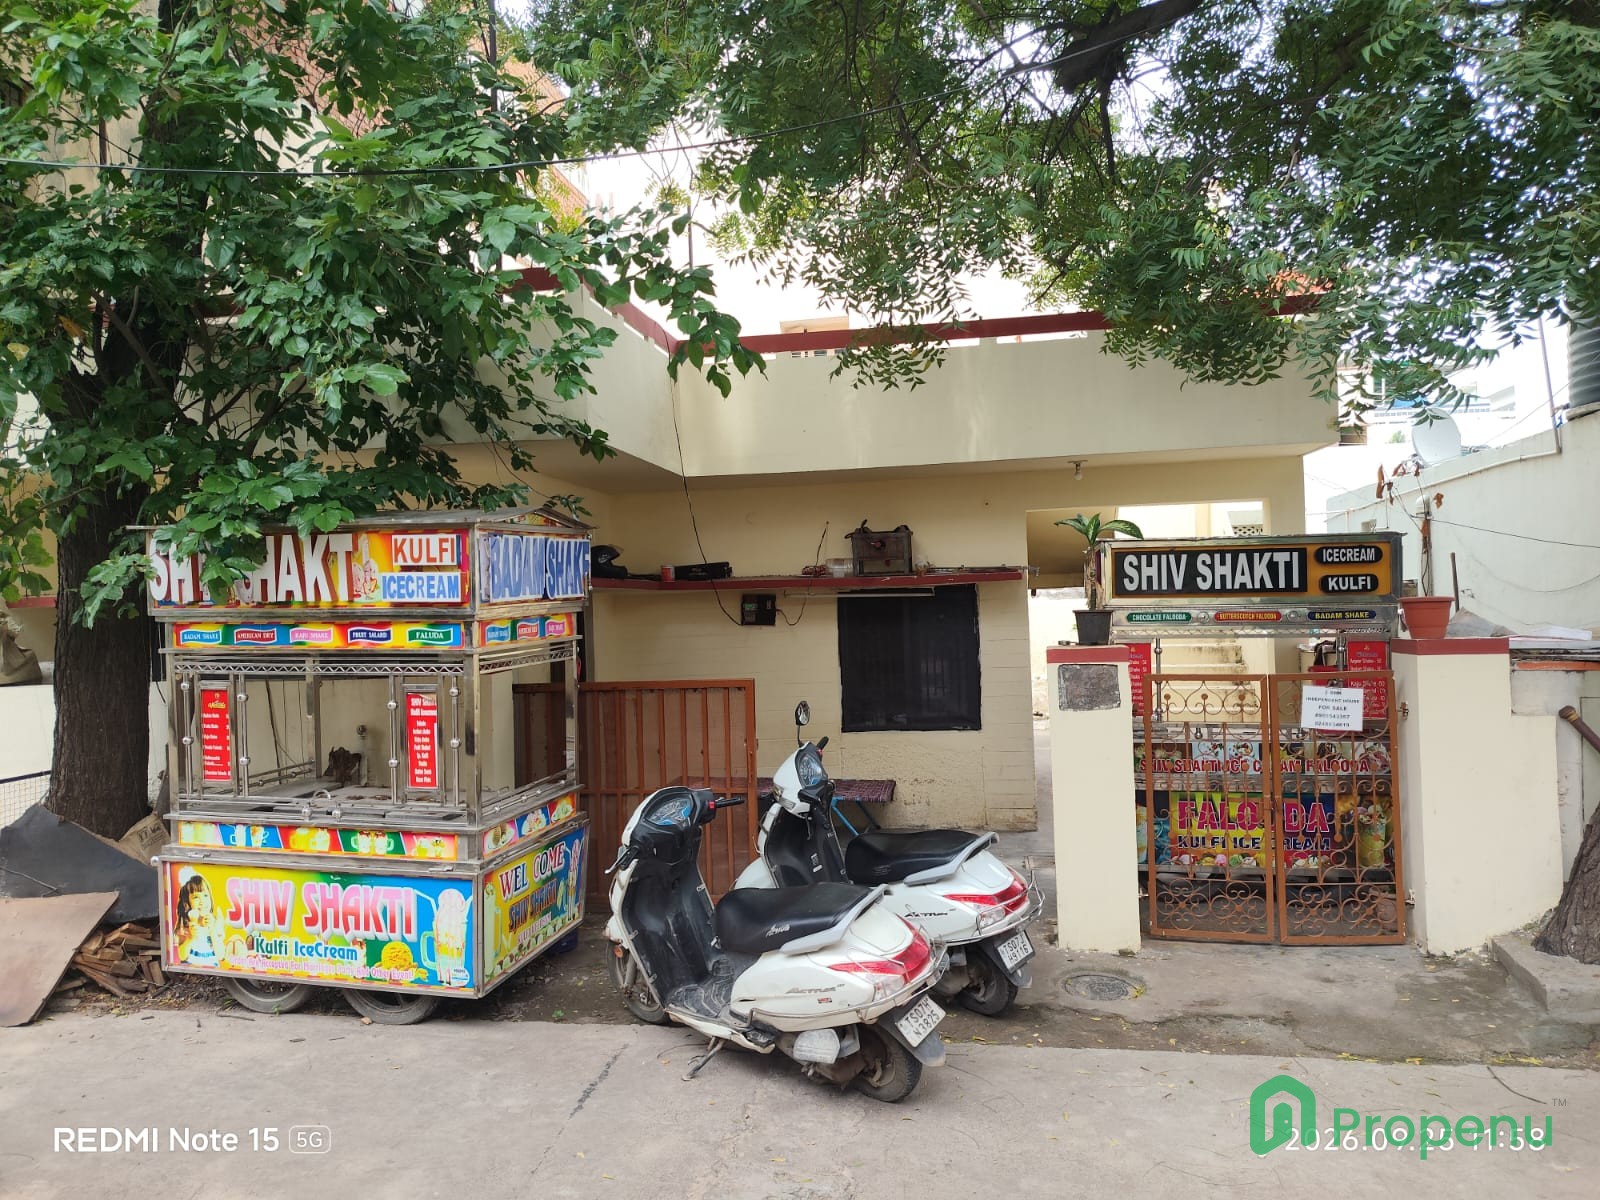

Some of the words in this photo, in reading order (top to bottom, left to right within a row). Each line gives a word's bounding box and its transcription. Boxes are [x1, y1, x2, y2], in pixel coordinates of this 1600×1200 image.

[393, 536, 455, 566] KULFI
[1322, 548, 1375, 562] ICECREAM
[1123, 554, 1187, 591] SHIV
[1196, 551, 1300, 590] SHAKTI
[1328, 576, 1371, 590] KULFI
[382, 575, 459, 599] ICECREAM
[1344, 611, 1369, 619] SHAKE
[416, 631, 444, 639] FALUDA
[1178, 801, 1329, 832] FALODA
[499, 861, 528, 903] WEL
[533, 841, 566, 882] COME
[227, 878, 295, 933] SHIV
[302, 883, 419, 942] SHAKTI
[255, 937, 288, 956] Kulfi
[294, 942, 358, 960] IceCream
